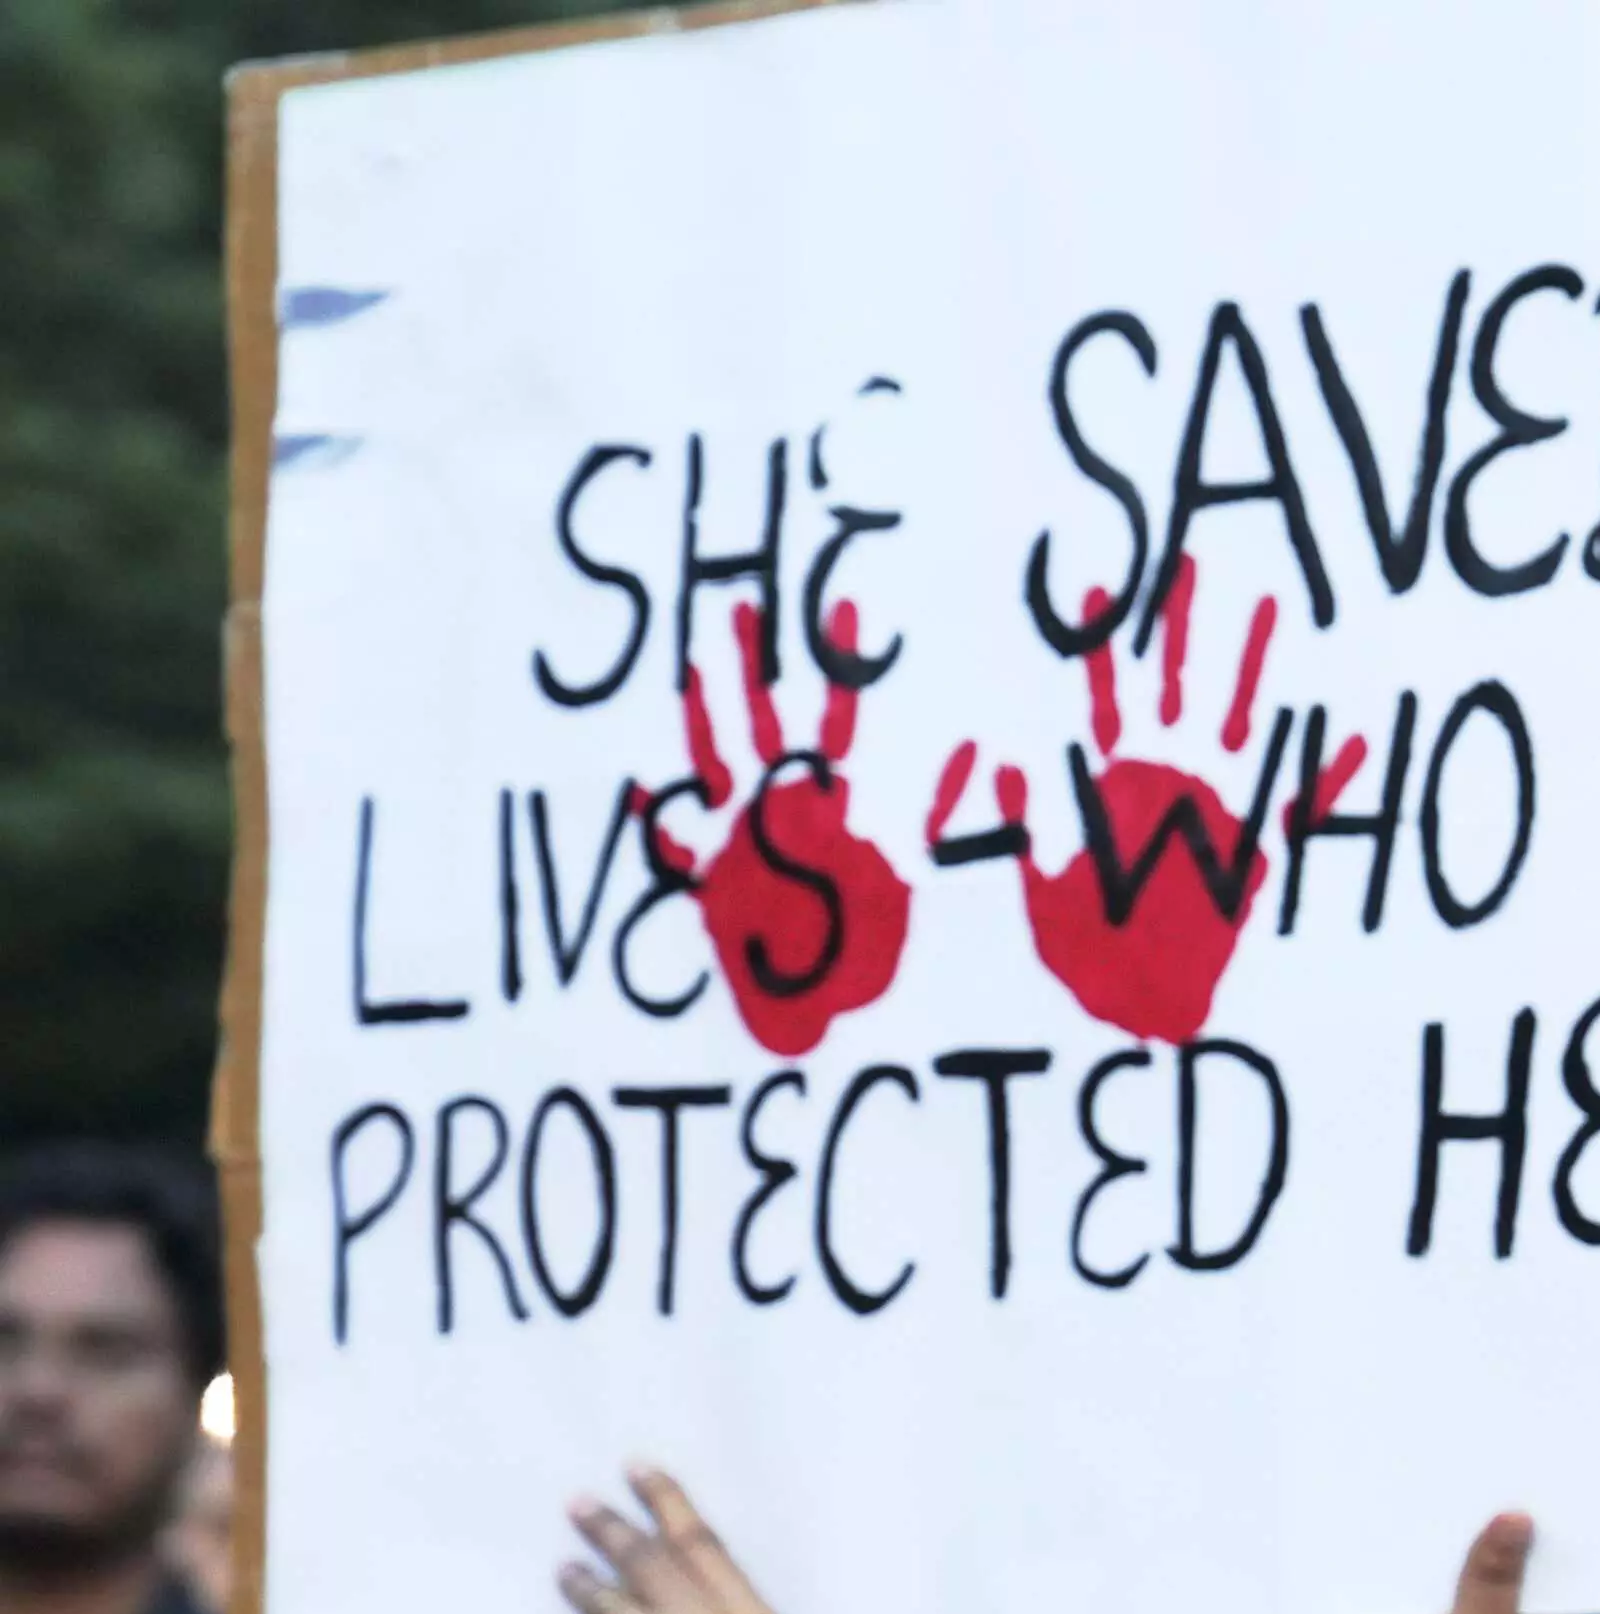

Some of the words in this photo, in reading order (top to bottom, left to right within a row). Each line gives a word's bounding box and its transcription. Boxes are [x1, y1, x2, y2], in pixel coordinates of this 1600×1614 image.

[532, 376, 905, 707] SHE
[353, 748, 844, 1027] LIVES
[1067, 677, 1539, 937] WHO
[330, 1040, 1290, 1346] PROTECTED
